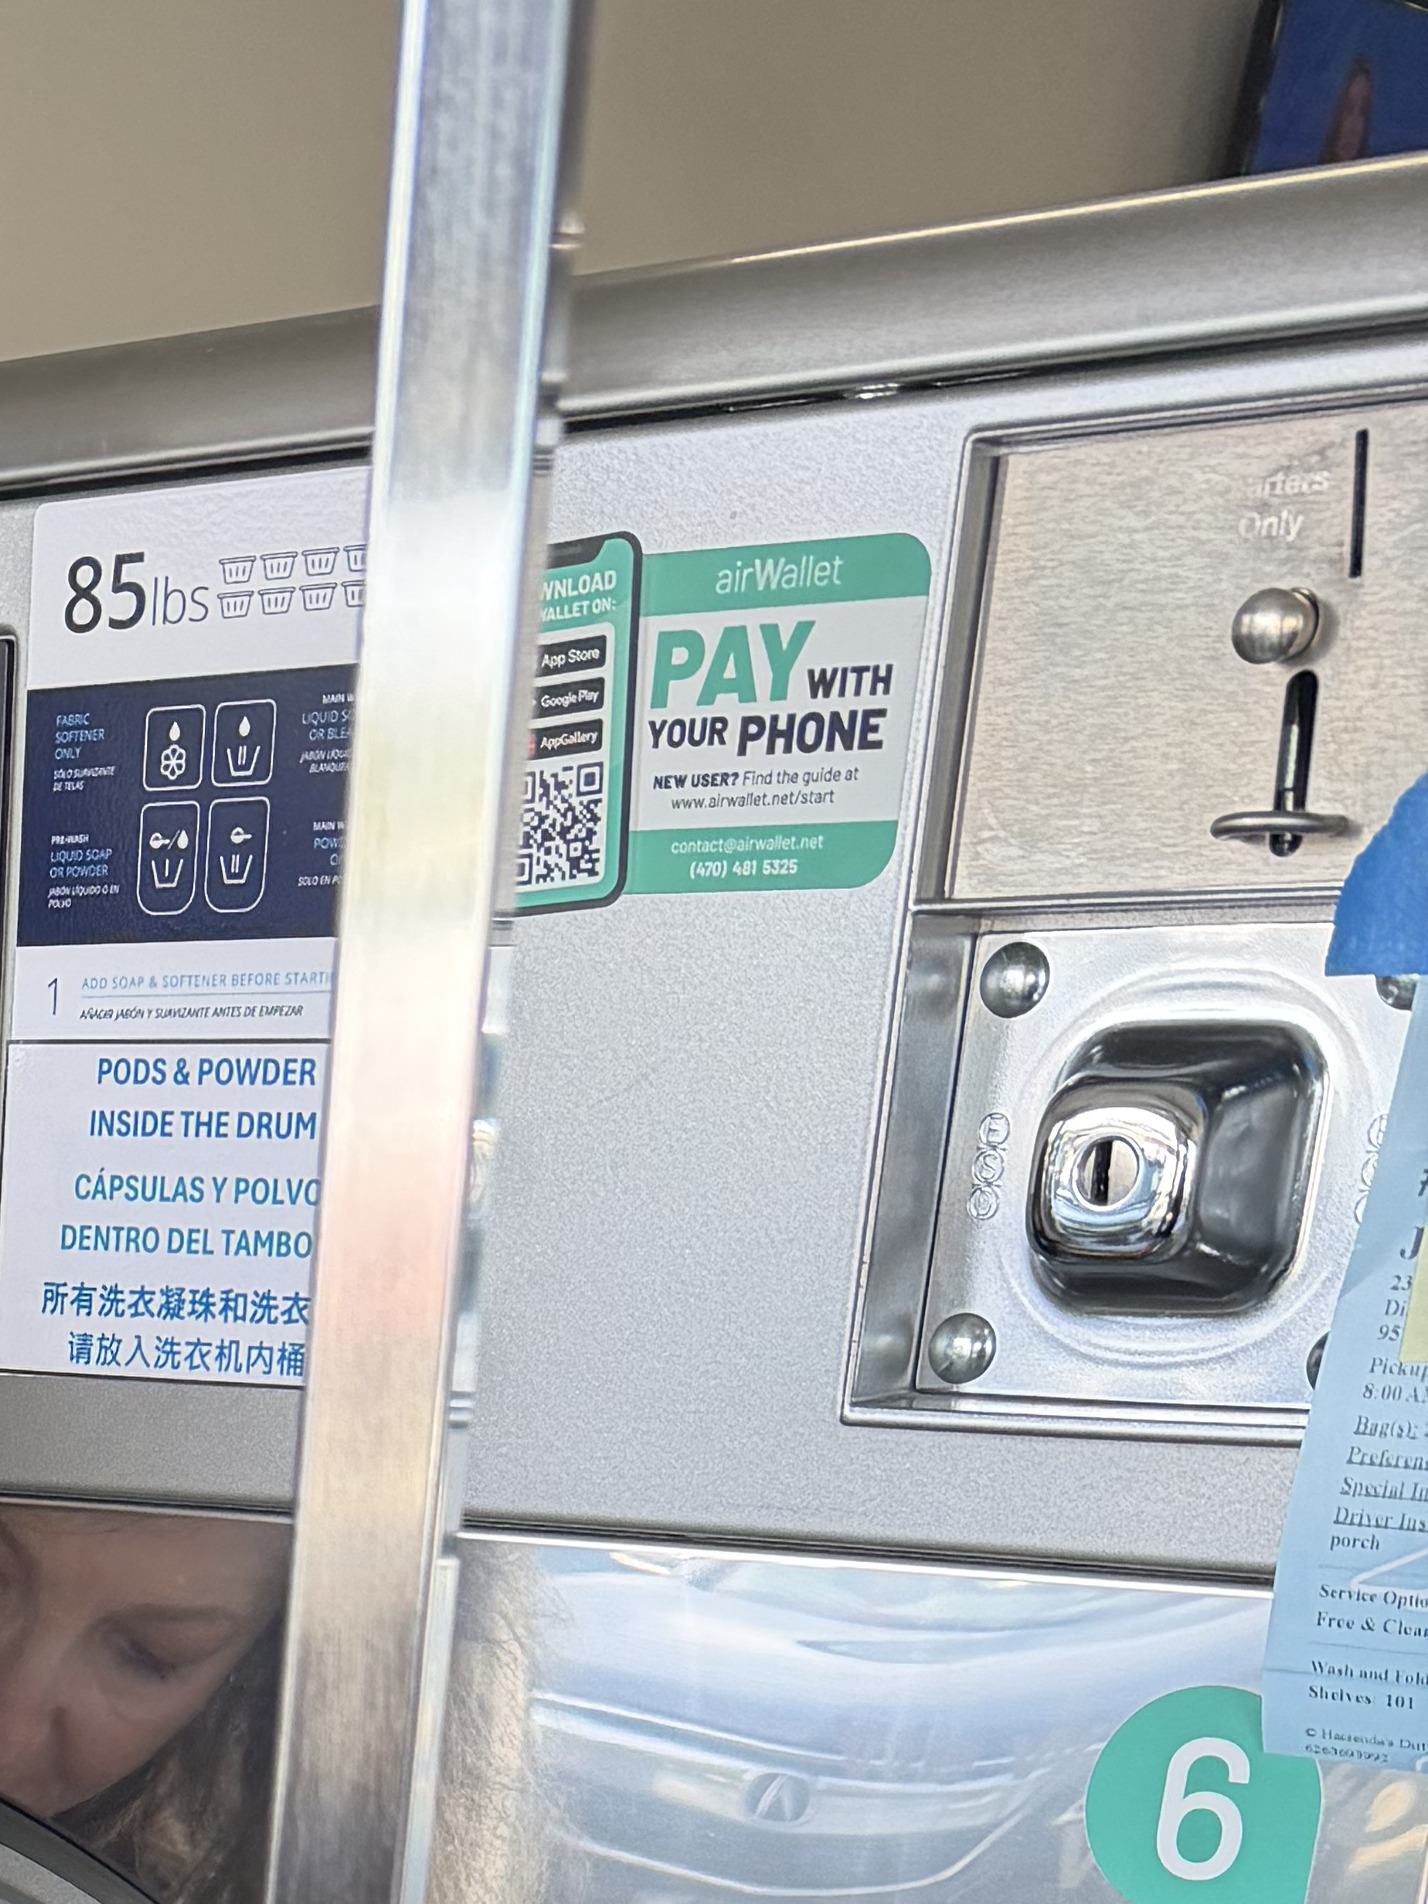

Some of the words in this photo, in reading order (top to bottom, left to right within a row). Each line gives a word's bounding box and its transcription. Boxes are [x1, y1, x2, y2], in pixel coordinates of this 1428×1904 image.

[1238, 508, 1305, 542] Only
[715, 555, 844, 594] airWallet
[592, 597, 617, 615] ON:
[542, 654, 566, 670] App
[568, 648, 600, 664] Store
[650, 620, 817, 710] PAY
[807, 664, 894, 699] WITH
[541, 694, 576, 709] Google
[578, 689, 600, 704] Play
[56, 713, 90, 727] FABRIC
[302, 710, 339, 726] LIQUID
[55, 729, 105, 744] SOFTENER
[309, 728, 324, 741] OR
[540, 730, 598, 750] AppGallery
[648, 716, 729, 750] YOUR
[737, 708, 888, 757] PHONE
[54, 747, 83, 760] ONLY
[653, 774, 688, 790] NEW
[691, 771, 739, 788] USER?
[742, 770, 773, 786] Find
[776, 769, 799, 784] the
[802, 766, 841, 787] guide
[844, 766, 859, 781] at
[671, 789, 835, 810] www.airwallet.net/start
[671, 835, 824, 854] contact@airwallet.net
[50, 849, 84, 863] LIQUID
[85, 848, 113, 862] SOAP
[49, 867, 64, 879] OR
[66, 864, 109, 878] POWDER
[690, 860, 727, 880] (470)
[732, 860, 757, 876] 481
[762, 858, 798, 875] 5325
[82, 977, 108, 990] ADD
[112, 976, 144, 990] SOAP
[148, 975, 158, 989] &
[162, 973, 227, 988] SOFTENER
[231, 972, 281, 987] BEFORE
[47, 977, 58, 1016] 1
[147, 1008, 154, 1019] Y
[211, 1005, 242, 1018] ANTES
[244, 1005, 258, 1018] DE
[259, 1004, 304, 1017] EMPEZAR
[97, 1058, 167, 1086] PODS
[173, 1058, 191, 1086] &
[198, 1058, 317, 1086] POWDER
[89, 1110, 175, 1138] INSIDE
[180, 1111, 230, 1138] THE
[236, 1112, 317, 1140] DRUM
[74, 1167, 206, 1203] CÁPSULAS
[212, 1176, 228, 1204] Y
[60, 1224, 161, 1253] DENTRO
[167, 1228, 215, 1256] DEL
[221, 1229, 313, 1259] TAMBO
[1362, 1382, 1403, 1402] 8:00
[1340, 1476, 1404, 1500] Special
[1333, 1506, 1394, 1529] Driver
[1330, 1534, 1380, 1551] porch
[1319, 1583, 1378, 1603] Service
[1316, 1611, 1355, 1630] Free
[1361, 1616, 1375, 1632] &
[1311, 1660, 1354, 1679] Wash
[1359, 1668, 1389, 1683] and
[1387, 1694, 1414, 1710] 101
[1156, 1736, 1251, 1881] 6
